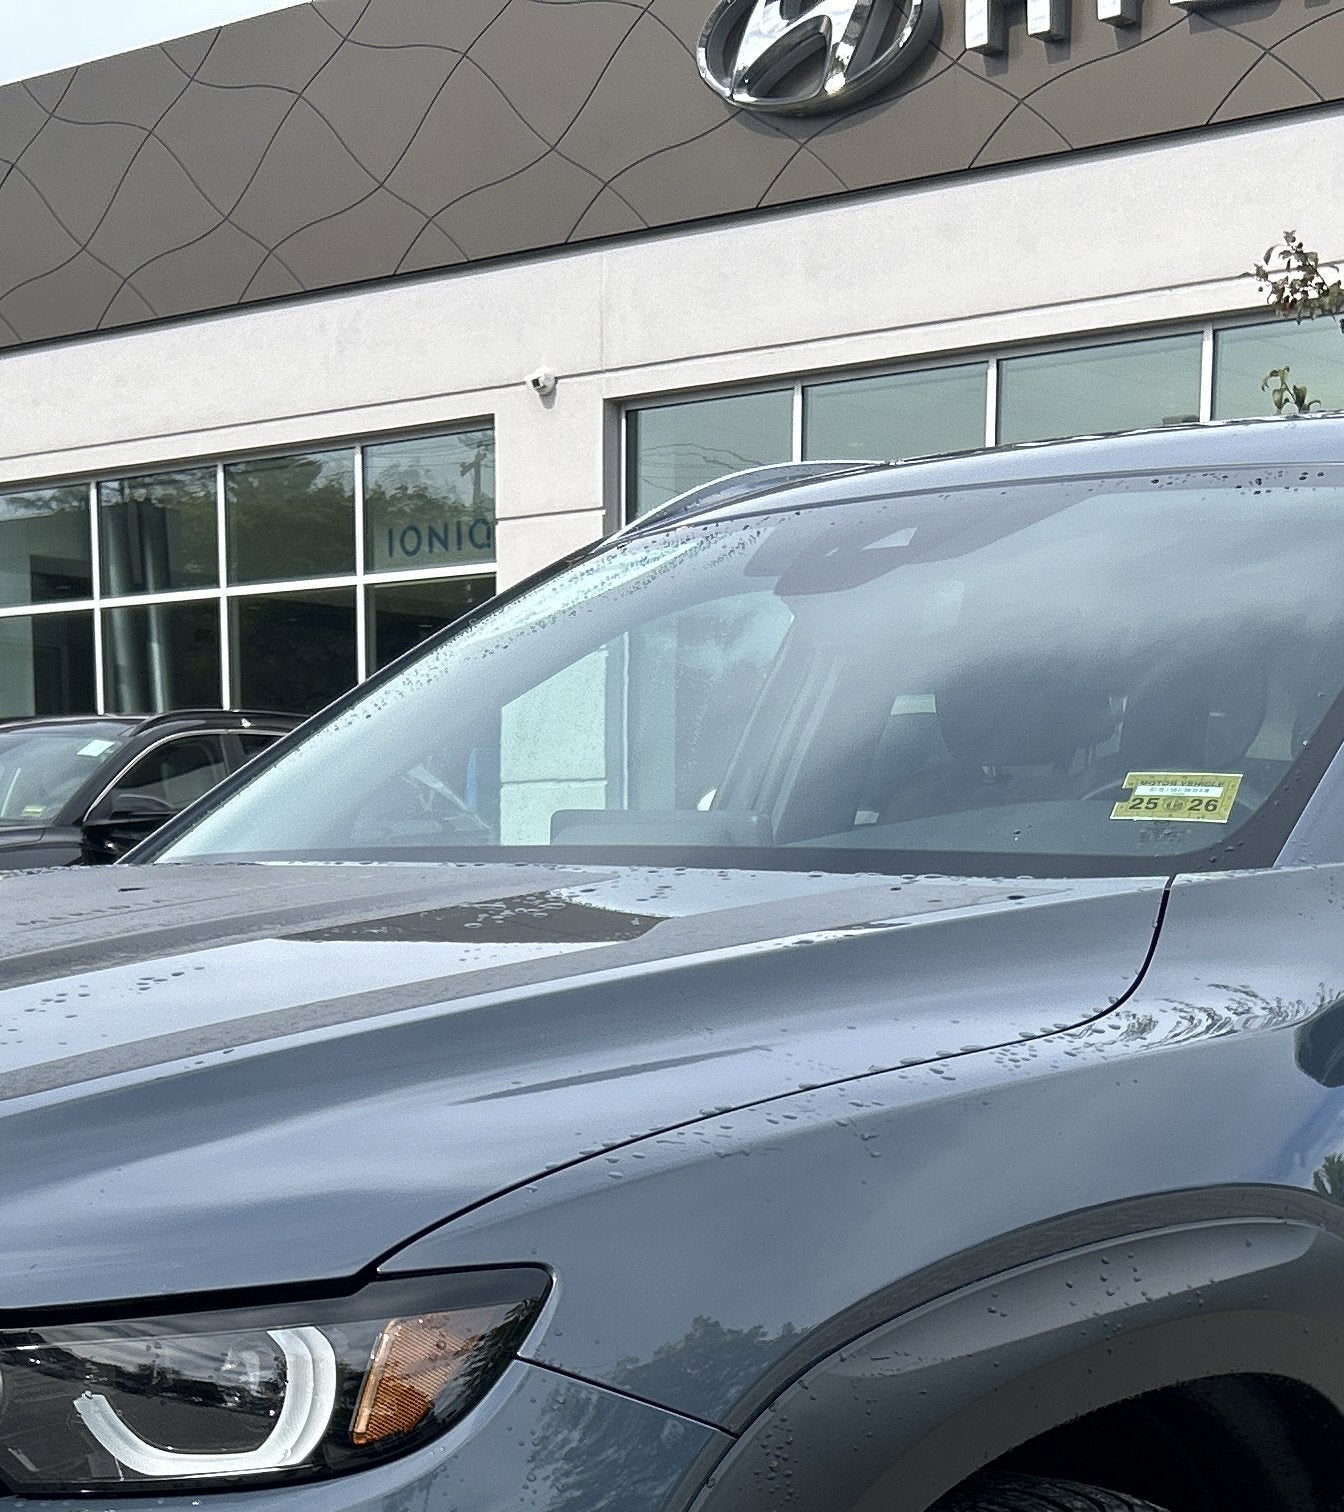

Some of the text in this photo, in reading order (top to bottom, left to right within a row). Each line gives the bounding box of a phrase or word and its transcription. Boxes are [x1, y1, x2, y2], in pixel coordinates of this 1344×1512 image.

[388, 518, 492, 558] IONIQ
[1128, 797, 1219, 812] 25 26
